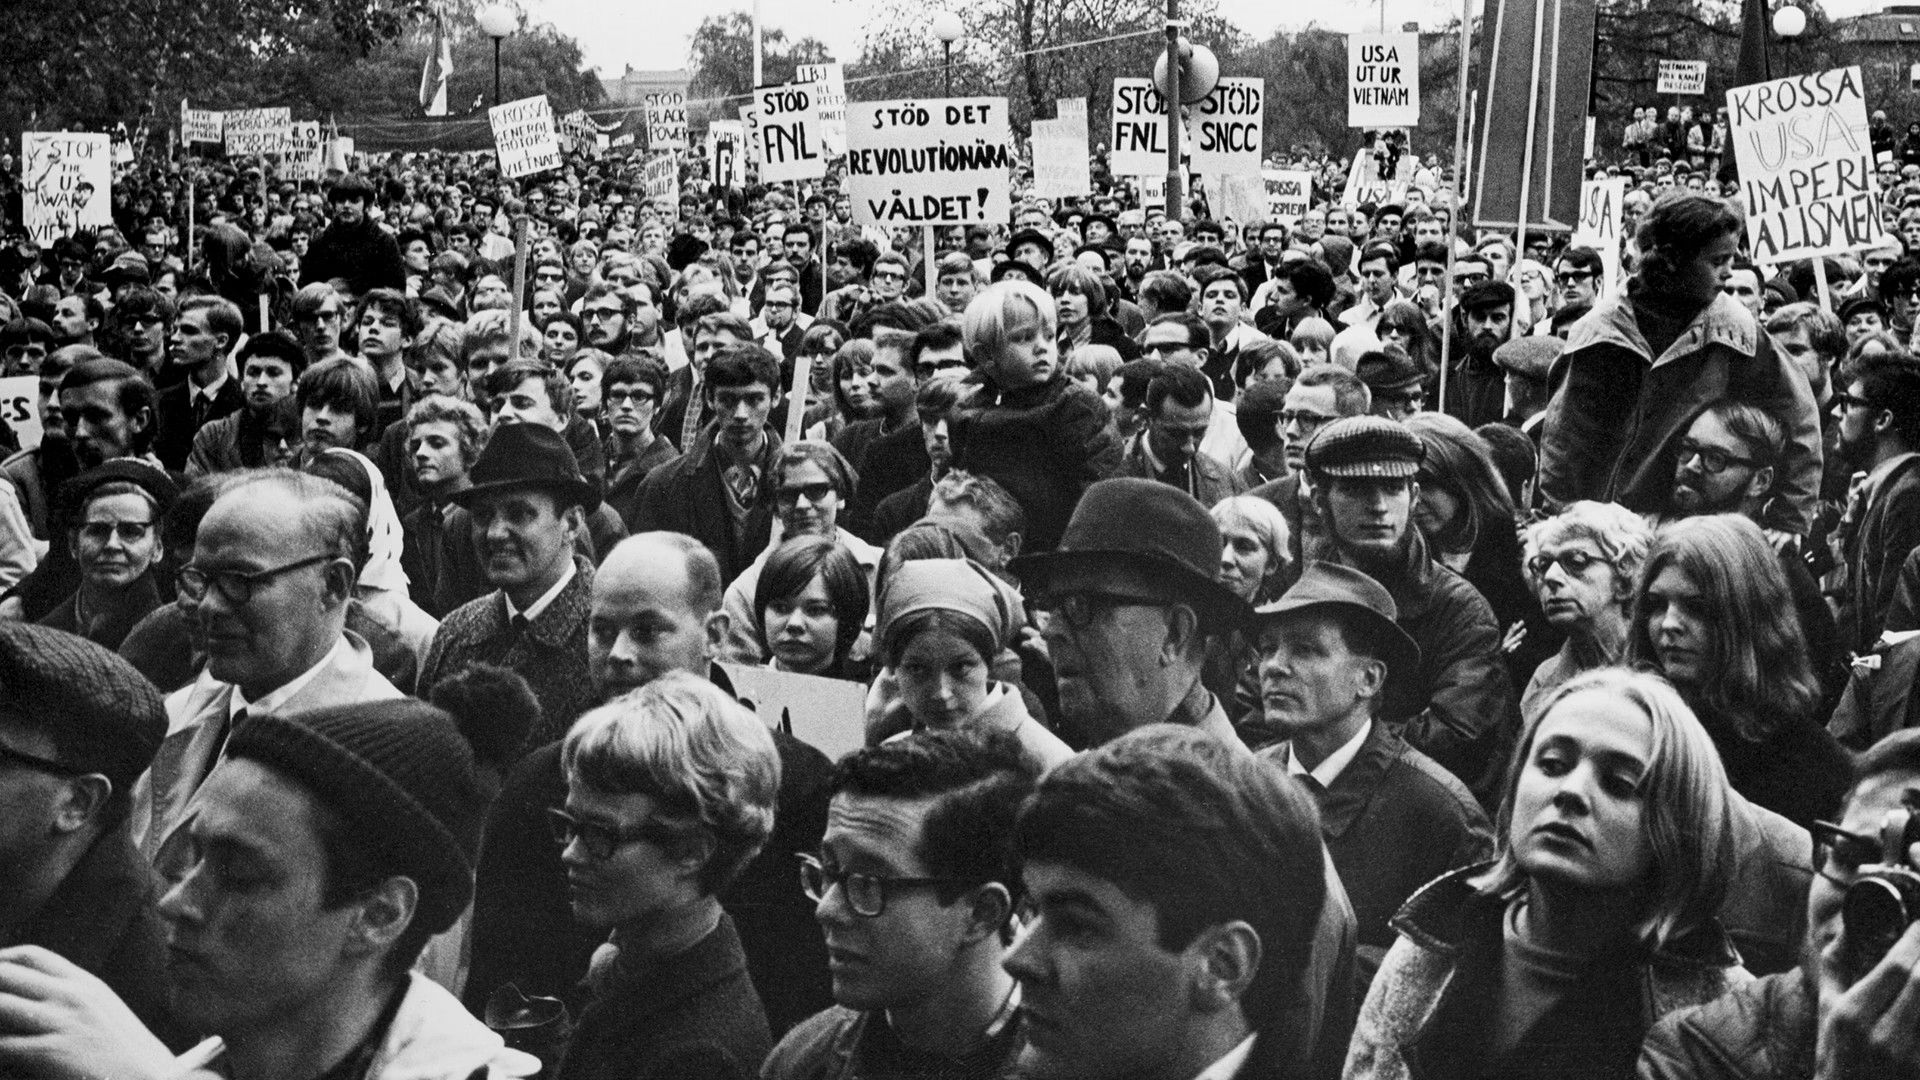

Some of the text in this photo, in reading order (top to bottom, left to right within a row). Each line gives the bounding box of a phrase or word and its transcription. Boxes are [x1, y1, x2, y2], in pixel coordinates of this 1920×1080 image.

[1362, 45, 1398, 63] USA
[1356, 65, 1401, 84] UT UR
[763, 88, 809, 115] STÖD
[1117, 83, 1169, 115] STÖ
[1200, 82, 1260, 115] STÖD
[1353, 87, 1408, 106] VIETNAM
[1734, 69, 1862, 127] KROSSA
[491, 100, 548, 128] KROSSA
[648, 109, 686, 123] BLACK
[872, 103, 991, 130] STÖD DET
[495, 122, 548, 143] GENERAL
[501, 134, 550, 153] MOTORS
[650, 126, 689, 143] POWER
[763, 121, 818, 164] FNL
[1115, 122, 1167, 154] FNL
[1200, 121, 1258, 153] SNCC
[51, 139, 101, 159] STOP
[850, 137, 1009, 176] REVOLUTIONÄRA
[503, 152, 562, 176] VIETNAM
[1263, 177, 1302, 196] ROSSA
[868, 187, 990, 221] VÅLDET!
[1753, 192, 1884, 259] ALISMEN
